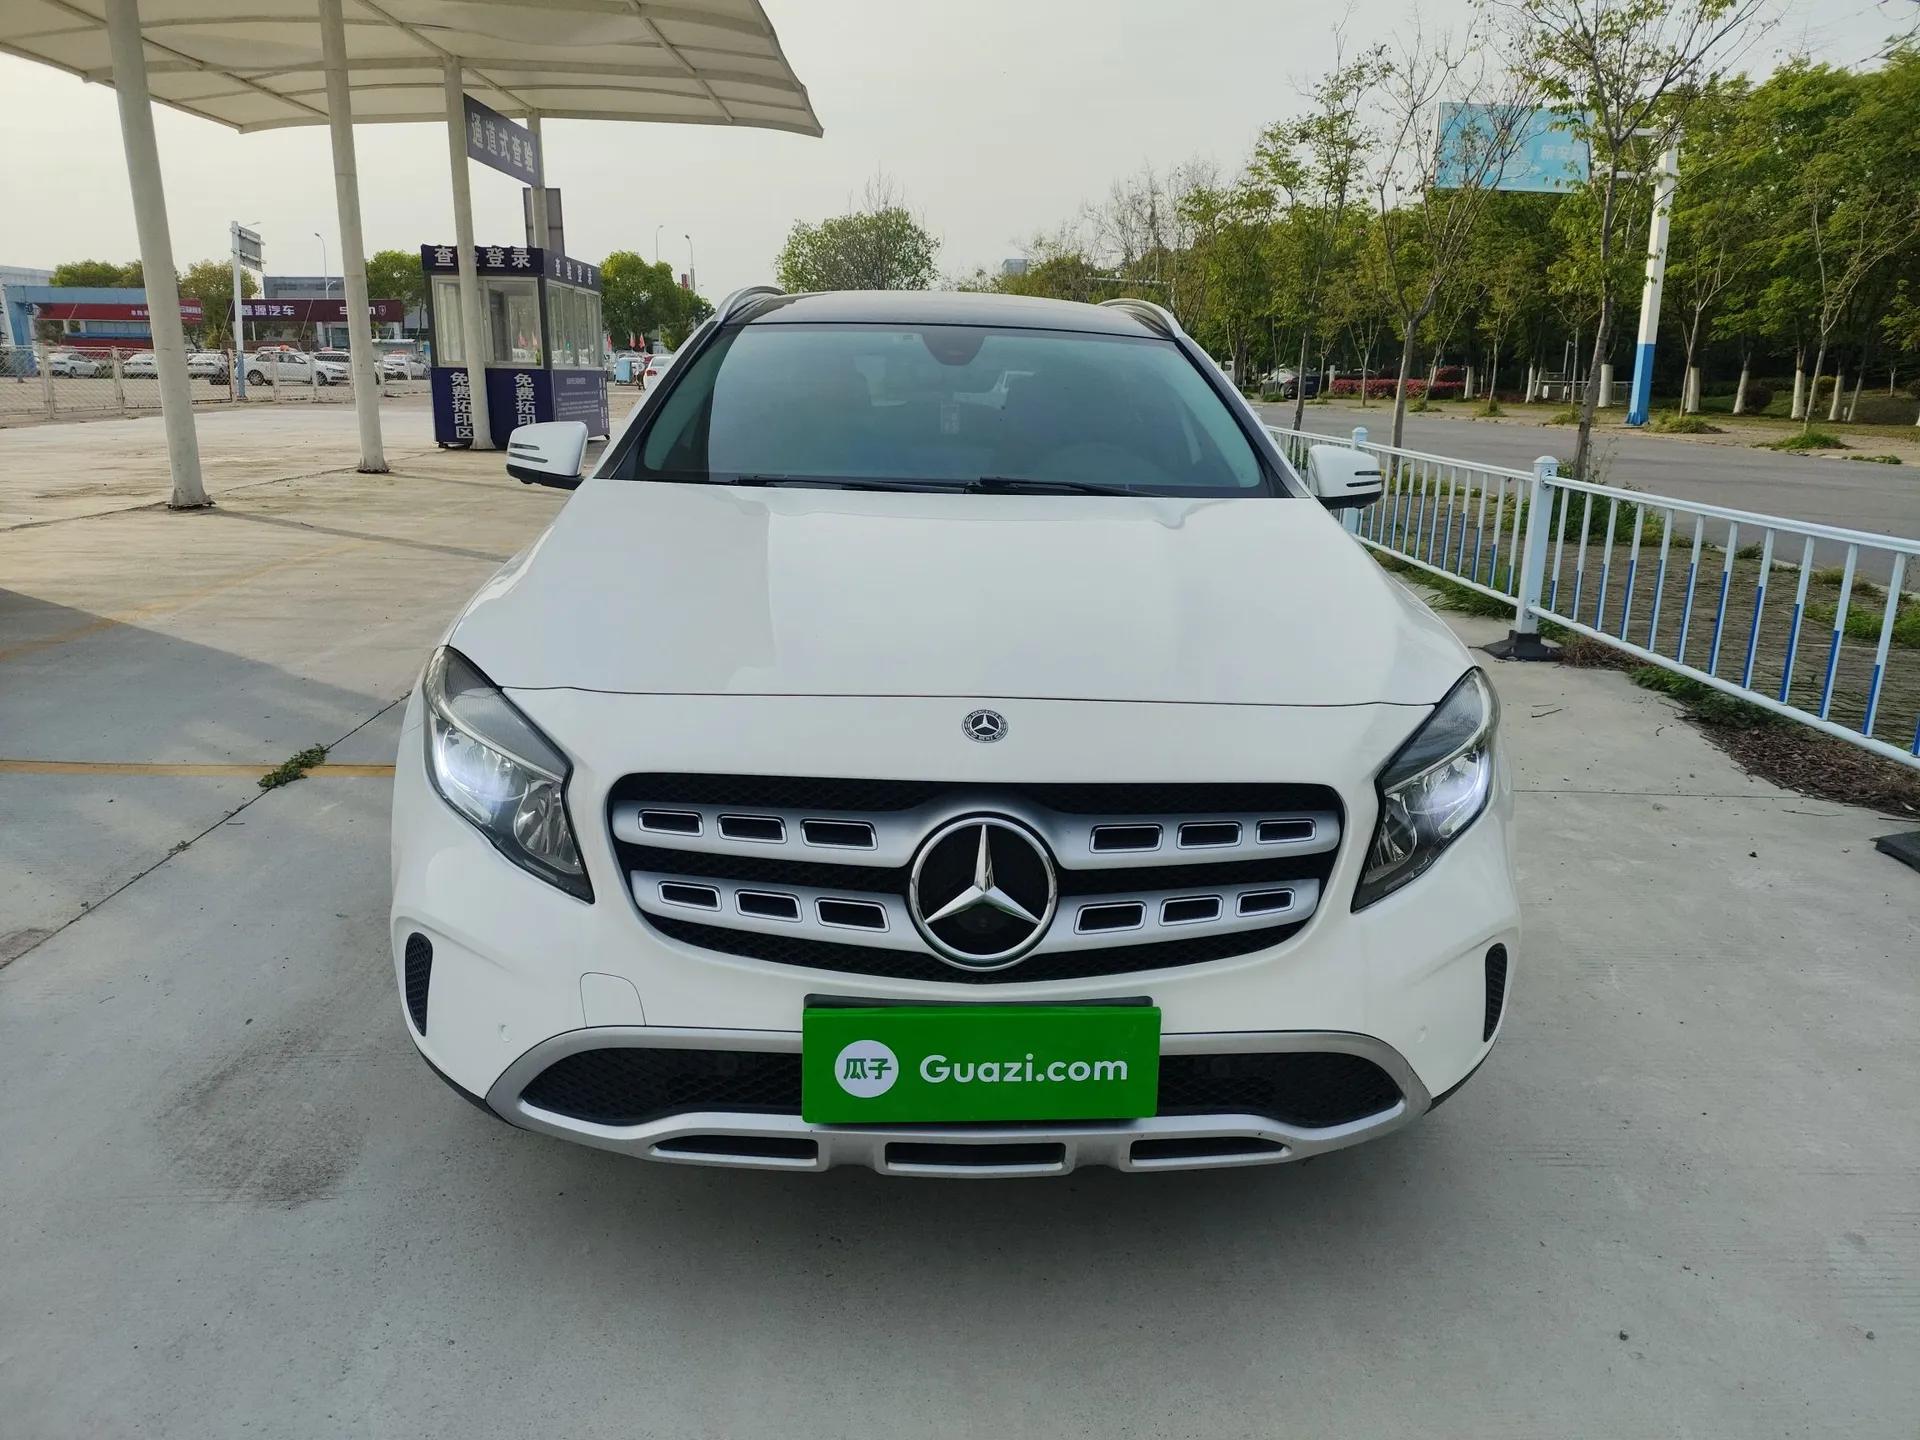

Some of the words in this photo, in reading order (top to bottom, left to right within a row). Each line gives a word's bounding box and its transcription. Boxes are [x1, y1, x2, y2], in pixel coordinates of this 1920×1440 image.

[471, 112, 535, 174] 通道式查验
[434, 246, 531, 268] 查登录
[450, 371, 474, 439] 免费拓印区
[843, 1057, 892, 1080] 瓜子
[919, 1053, 1128, 1083] Guazi.com
